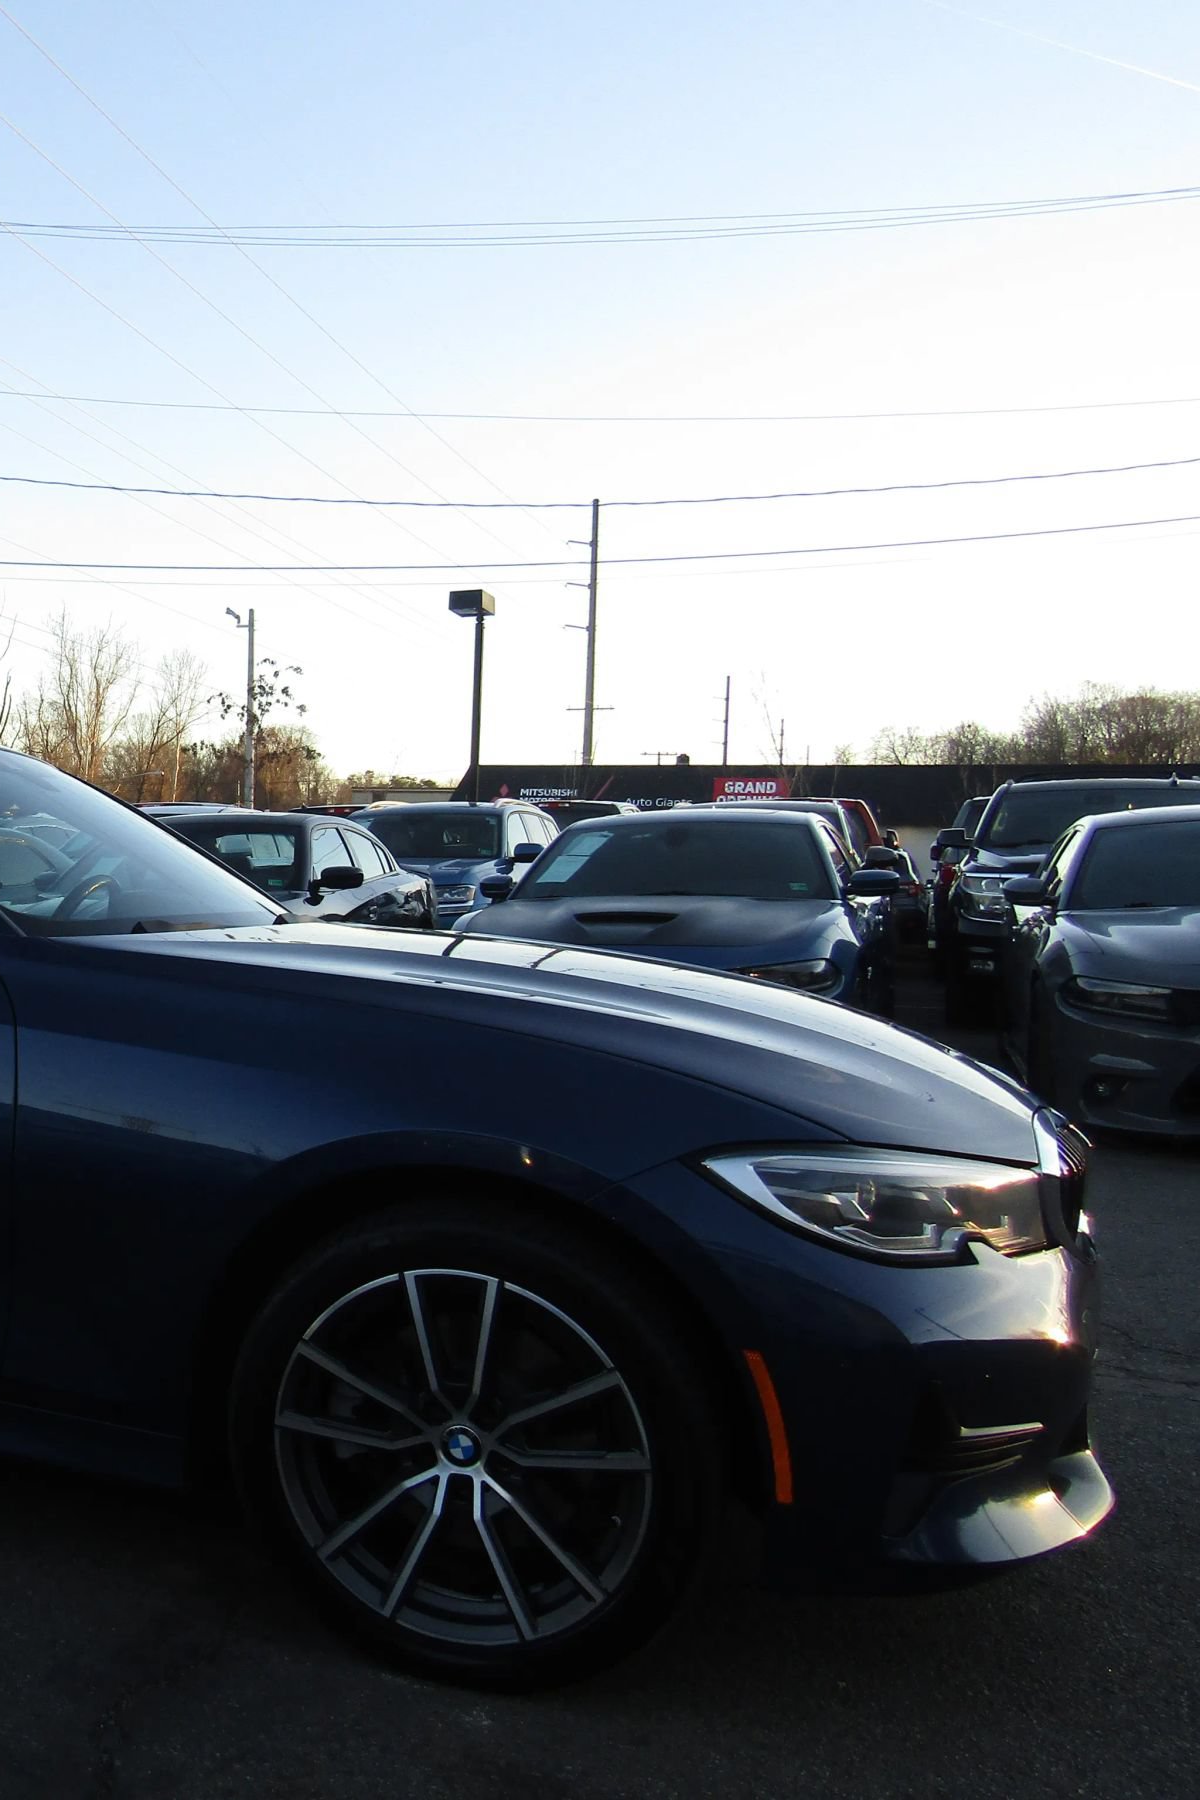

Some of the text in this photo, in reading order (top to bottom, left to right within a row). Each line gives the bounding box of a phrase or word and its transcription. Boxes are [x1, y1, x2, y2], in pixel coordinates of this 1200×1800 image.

[519, 788, 578, 797] MITSUBISHI
[725, 781, 777, 794] GRAND
[626, 797, 653, 807] Auto
